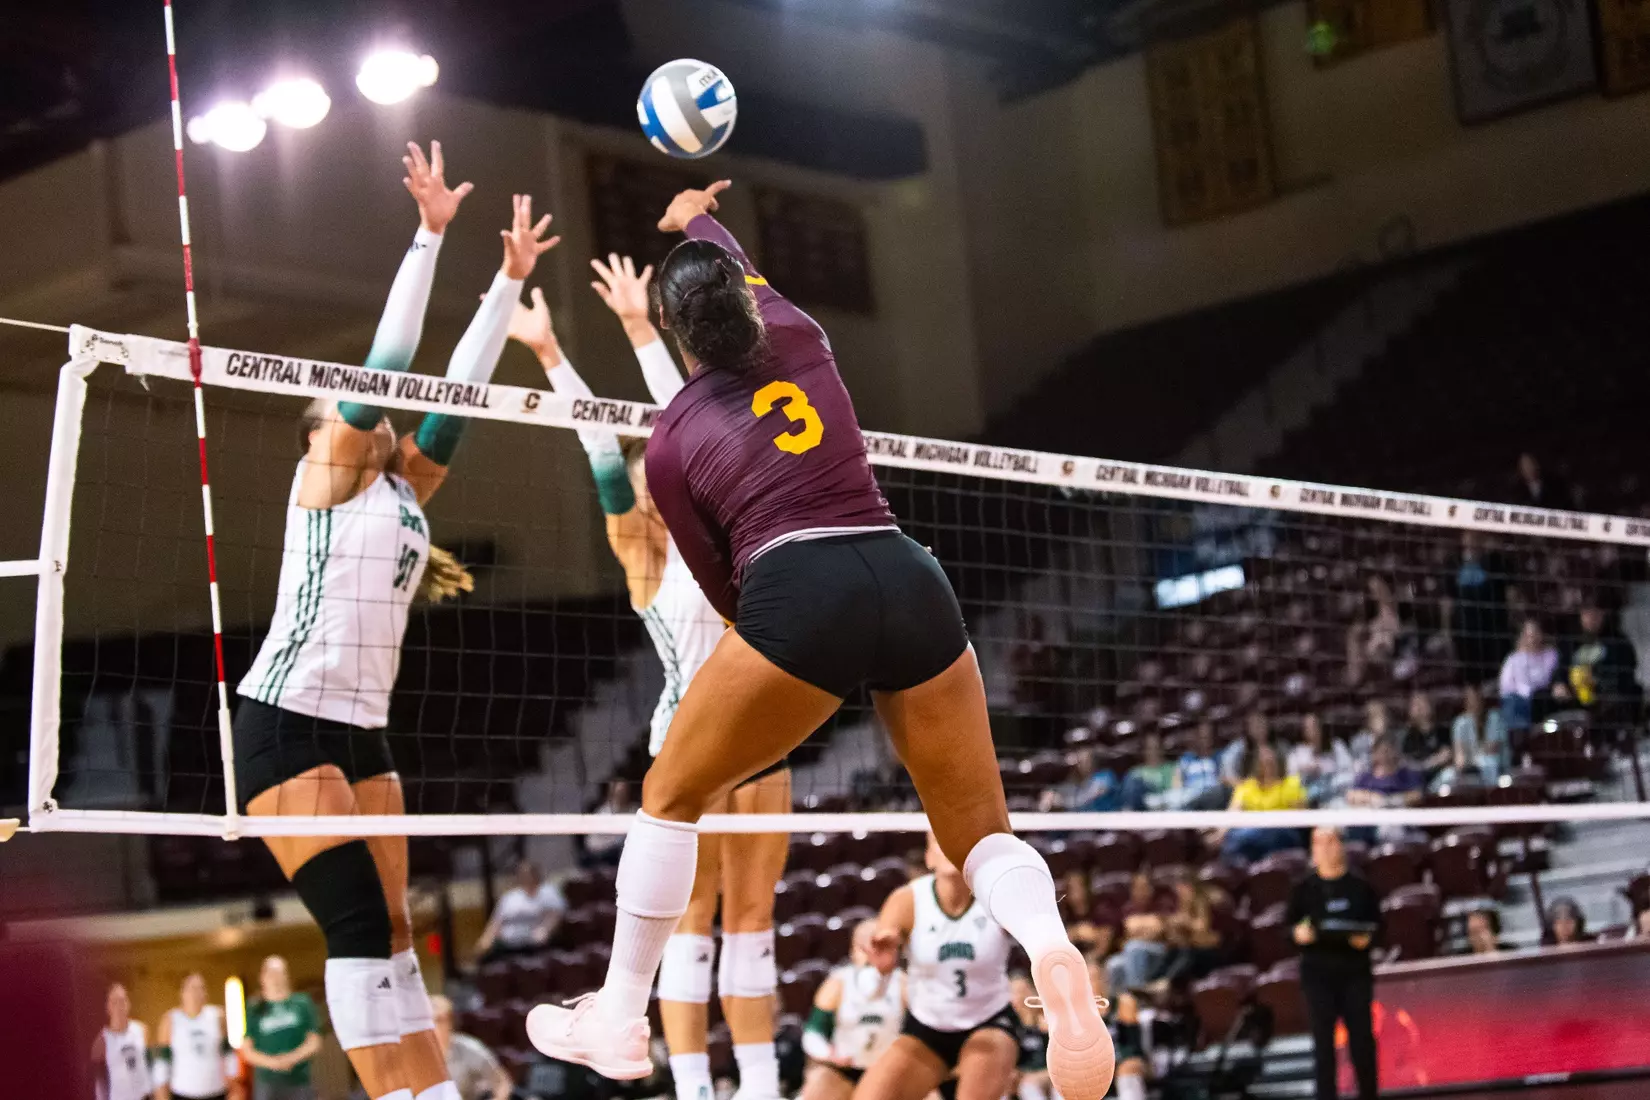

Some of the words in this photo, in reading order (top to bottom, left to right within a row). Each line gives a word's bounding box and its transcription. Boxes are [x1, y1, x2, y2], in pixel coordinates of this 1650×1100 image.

[226, 352, 301, 385] CENTRAL
[308, 364, 390, 397] MICHIGAN
[395, 375, 490, 409] VOLLEYBALL
[572, 399, 633, 426] CENTRAL
[751, 380, 825, 455] 3
[973, 450, 1038, 474] VOLLEYBALL
[954, 968, 967, 997] 3
